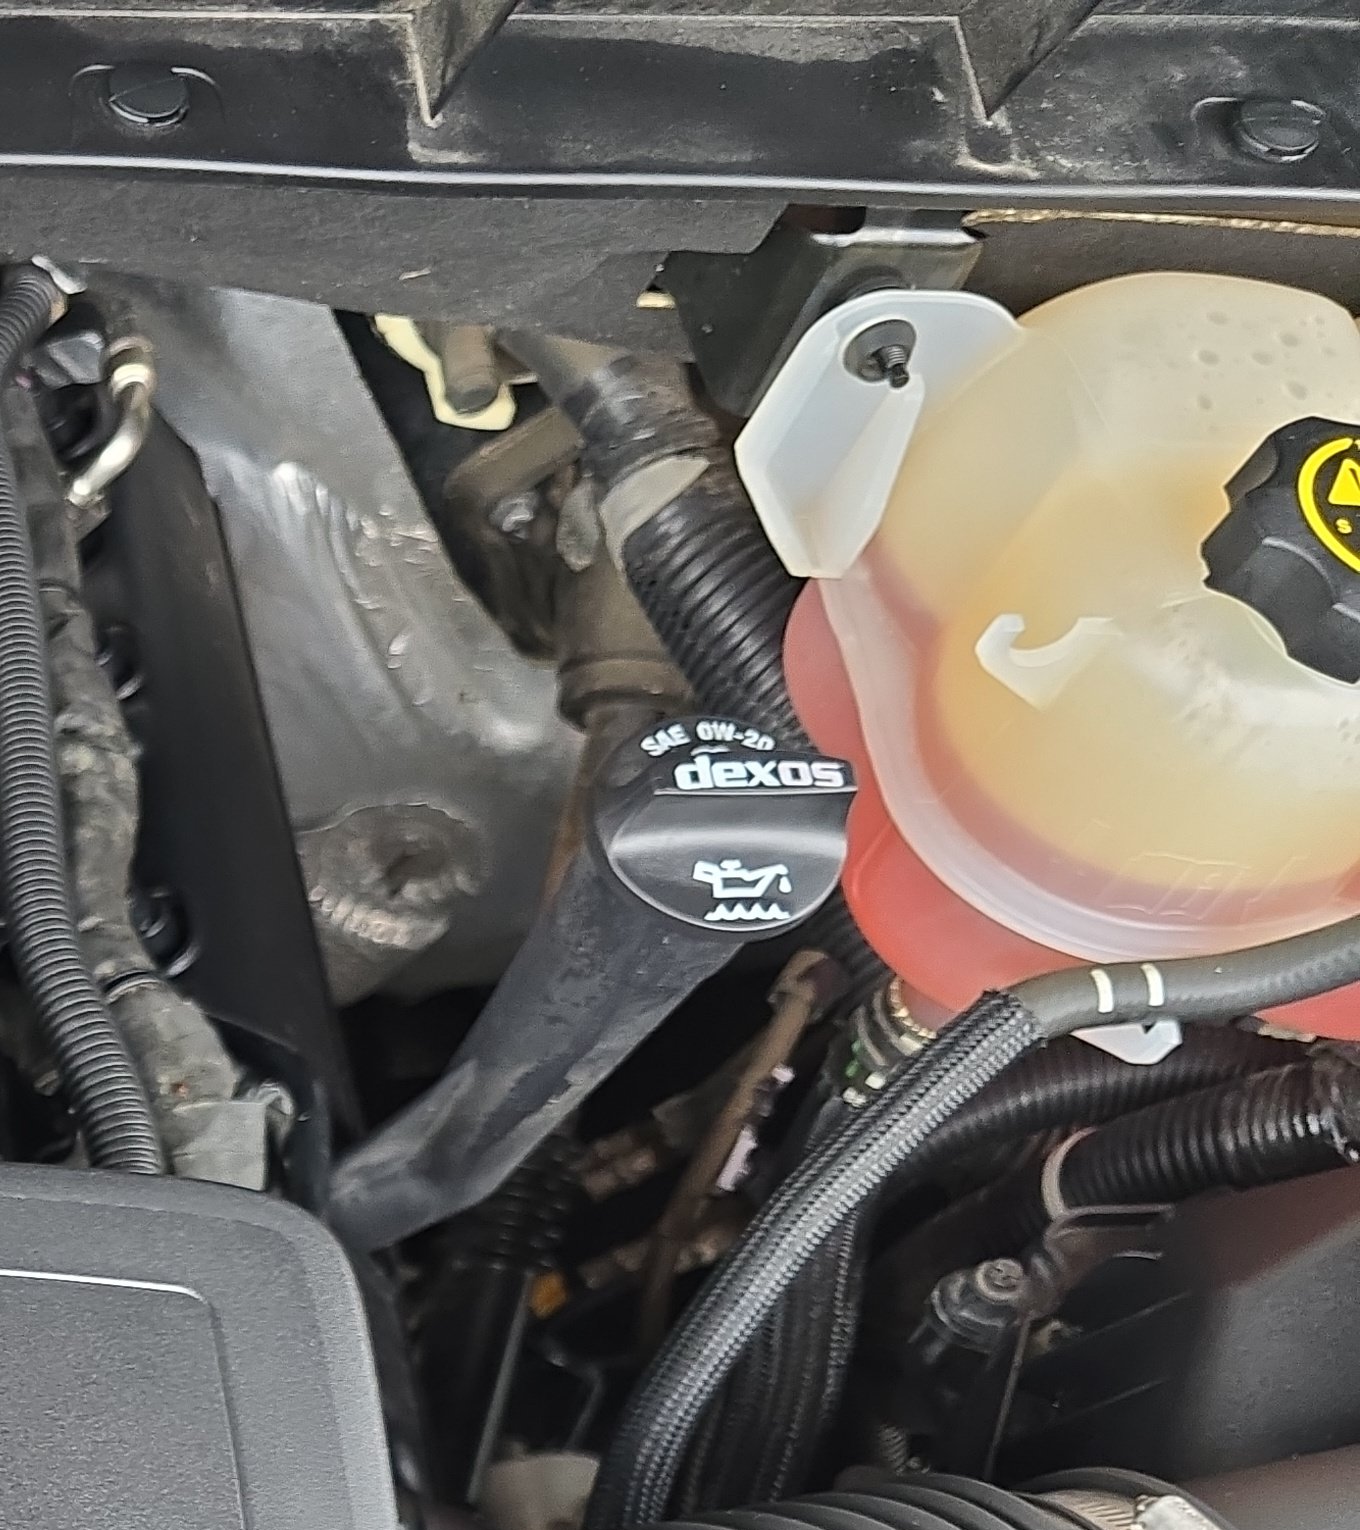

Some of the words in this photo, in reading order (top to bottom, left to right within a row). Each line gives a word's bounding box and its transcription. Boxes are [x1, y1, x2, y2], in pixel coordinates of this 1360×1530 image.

[640, 723, 692, 757] SAE
[696, 720, 776, 751] 0W-20
[674, 755, 845, 790] dexos
